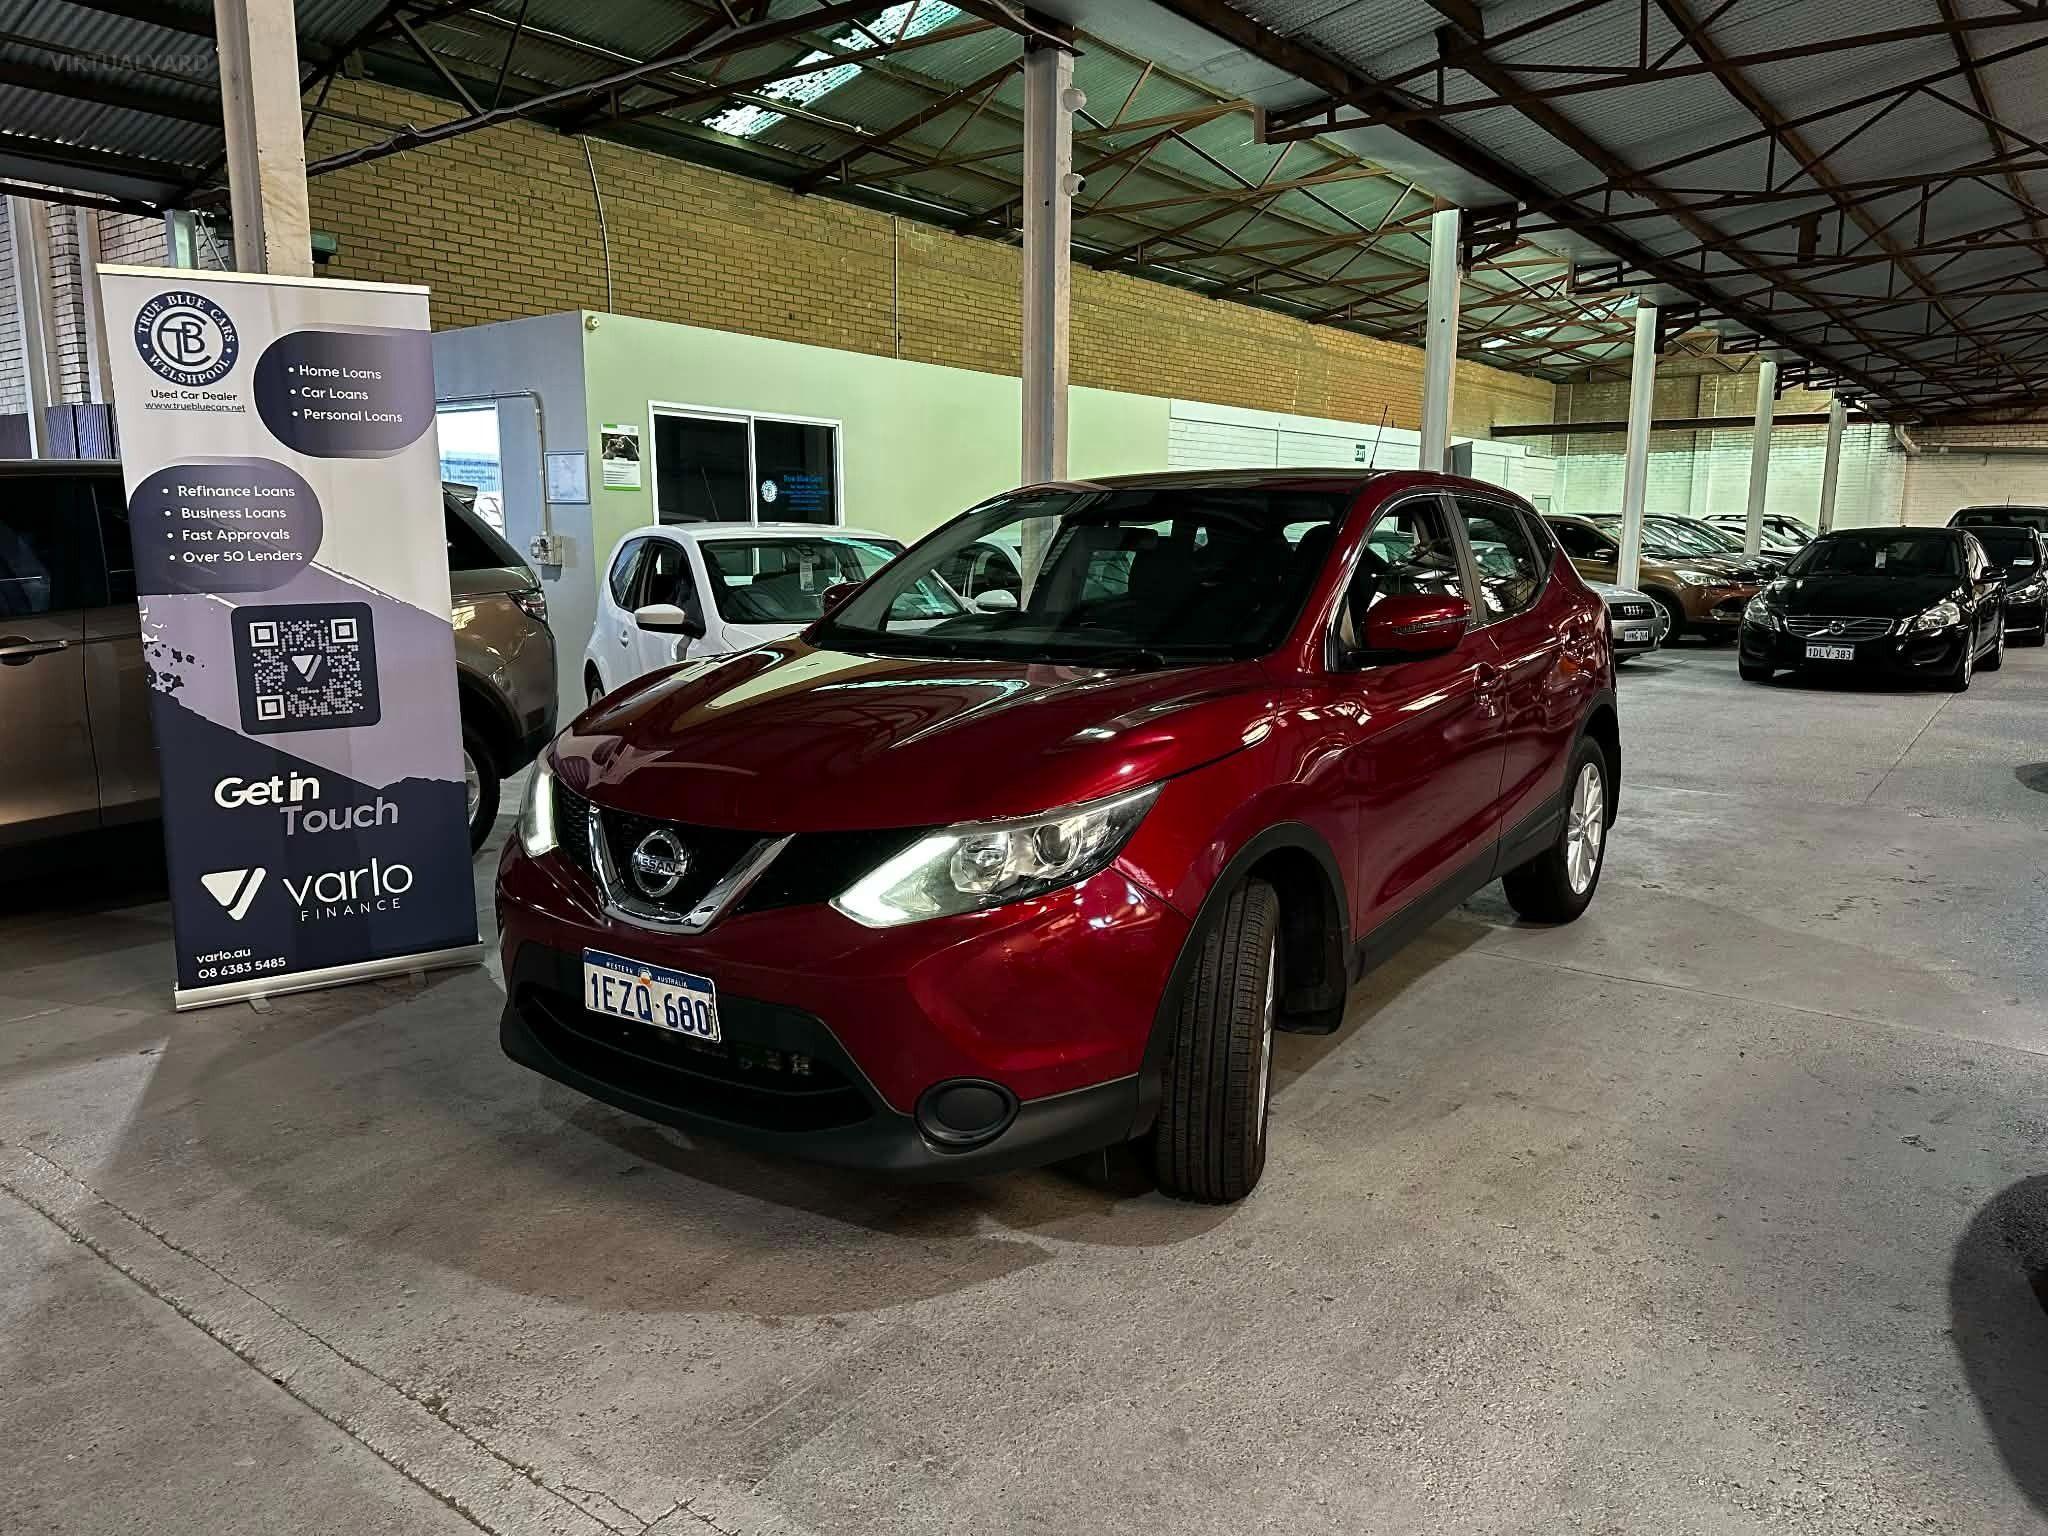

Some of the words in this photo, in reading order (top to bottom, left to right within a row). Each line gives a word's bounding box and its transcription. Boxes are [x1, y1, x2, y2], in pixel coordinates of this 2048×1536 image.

[137, 301, 163, 333] TRUE
[166, 294, 206, 309] BLUE
[210, 308, 235, 342] CARS
[149, 354, 231, 384] WELSHPOOL
[299, 365, 339, 378] Home
[342, 366, 382, 380] Loans
[151, 389, 178, 399] Used
[180, 390, 199, 400] Car
[202, 391, 238, 401] Dealer
[301, 387, 326, 399] Car
[328, 388, 369, 401] Loans
[145, 401, 245, 412] www.truebluecars.net
[304, 408, 362, 421] Personal
[364, 410, 403, 423] Loans
[178, 485, 251, 497] Refinance
[254, 486, 296, 498] Loans
[181, 507, 242, 519] Business
[245, 507, 286, 519] Loans
[182, 529, 213, 541] Fast
[217, 528, 290, 543] Approvals
[183, 551, 219, 563] Over
[223, 550, 244, 562] 50
[247, 549, 303, 562] Lenders
[214, 774, 283, 809] Get
[289, 771, 320, 802] in
[279, 796, 399, 836] Touch
[633, 854, 677, 874] NISSAN
[282, 857, 413, 907] varlo
[301, 897, 401, 922] FINANCE
[196, 948, 252, 963] varlo.au
[198, 965, 218, 979] 08
[220, 961, 252, 976] 6383
[255, 957, 287, 972] 5485
[605, 961, 633, 974] WESTERN
[656, 975, 688, 988] AUSTRALIA
